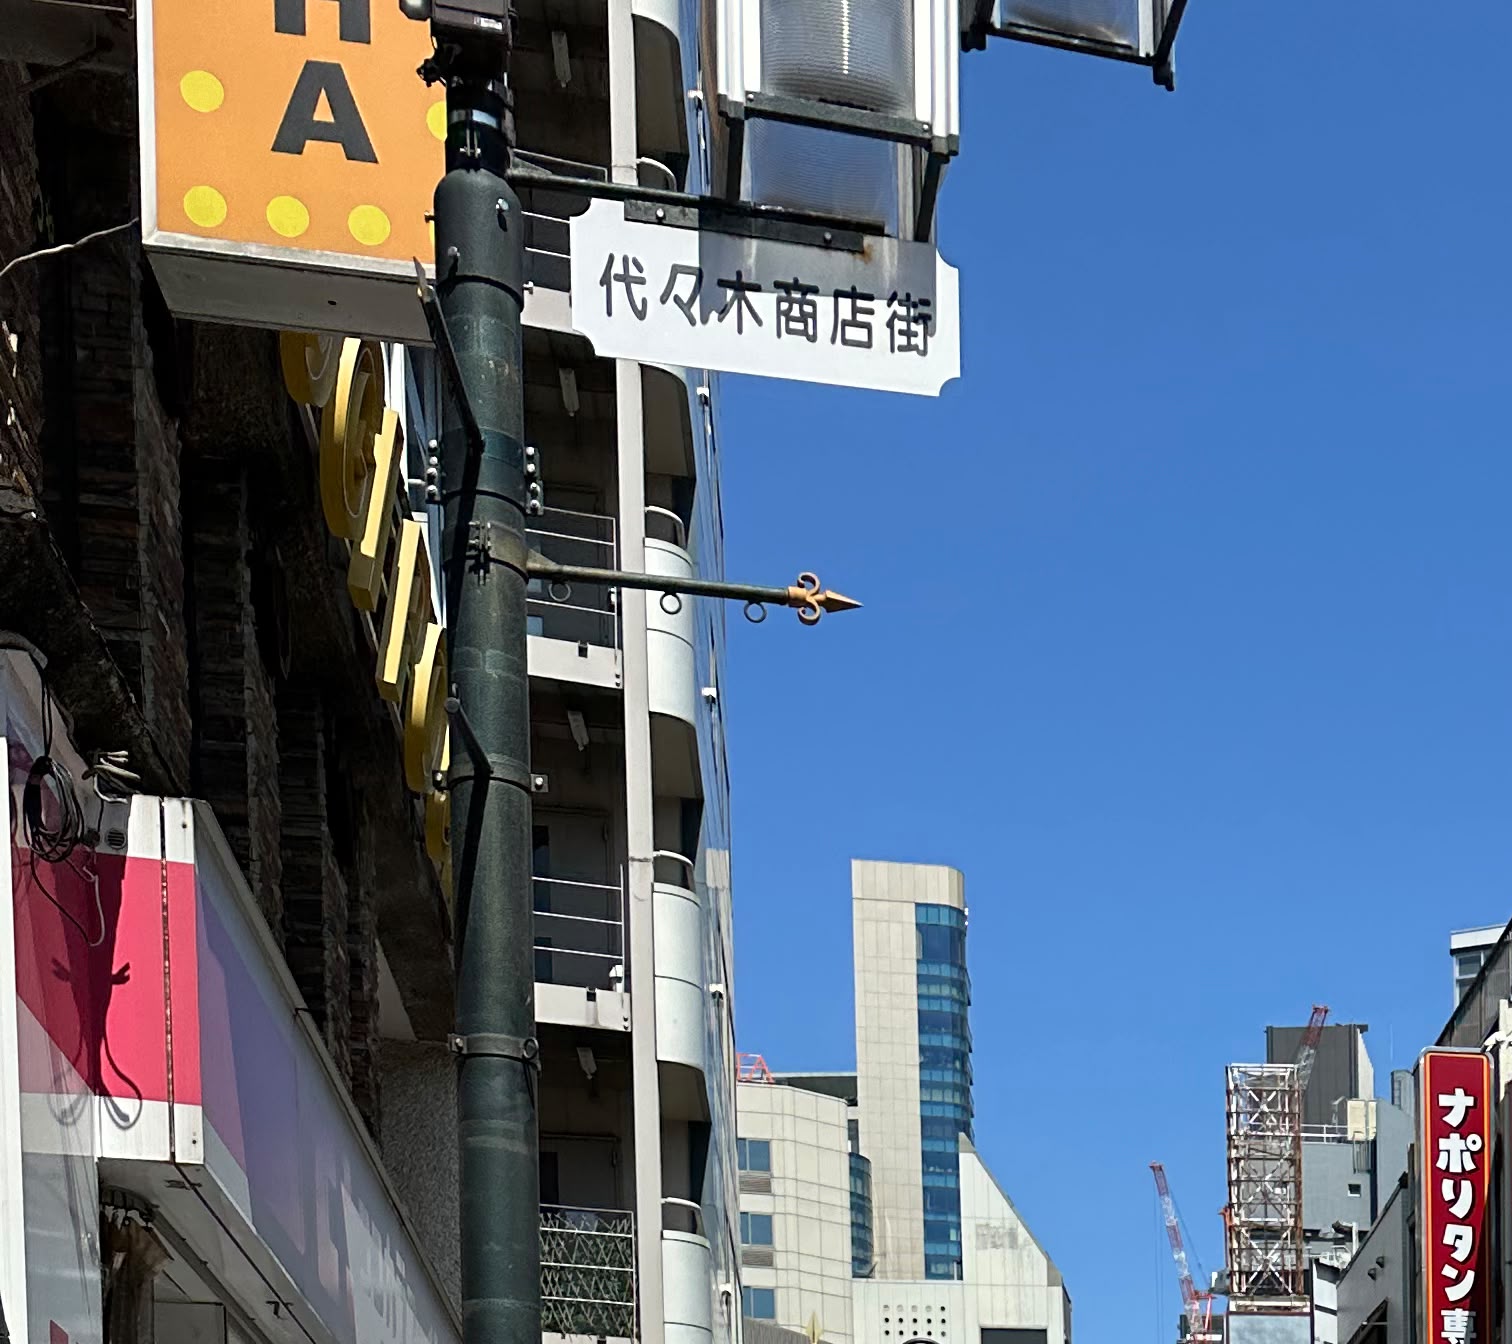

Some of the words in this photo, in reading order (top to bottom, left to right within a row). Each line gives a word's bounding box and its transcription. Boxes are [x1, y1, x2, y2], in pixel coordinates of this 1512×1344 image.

[600, 254, 932, 356] 代々木商店街
